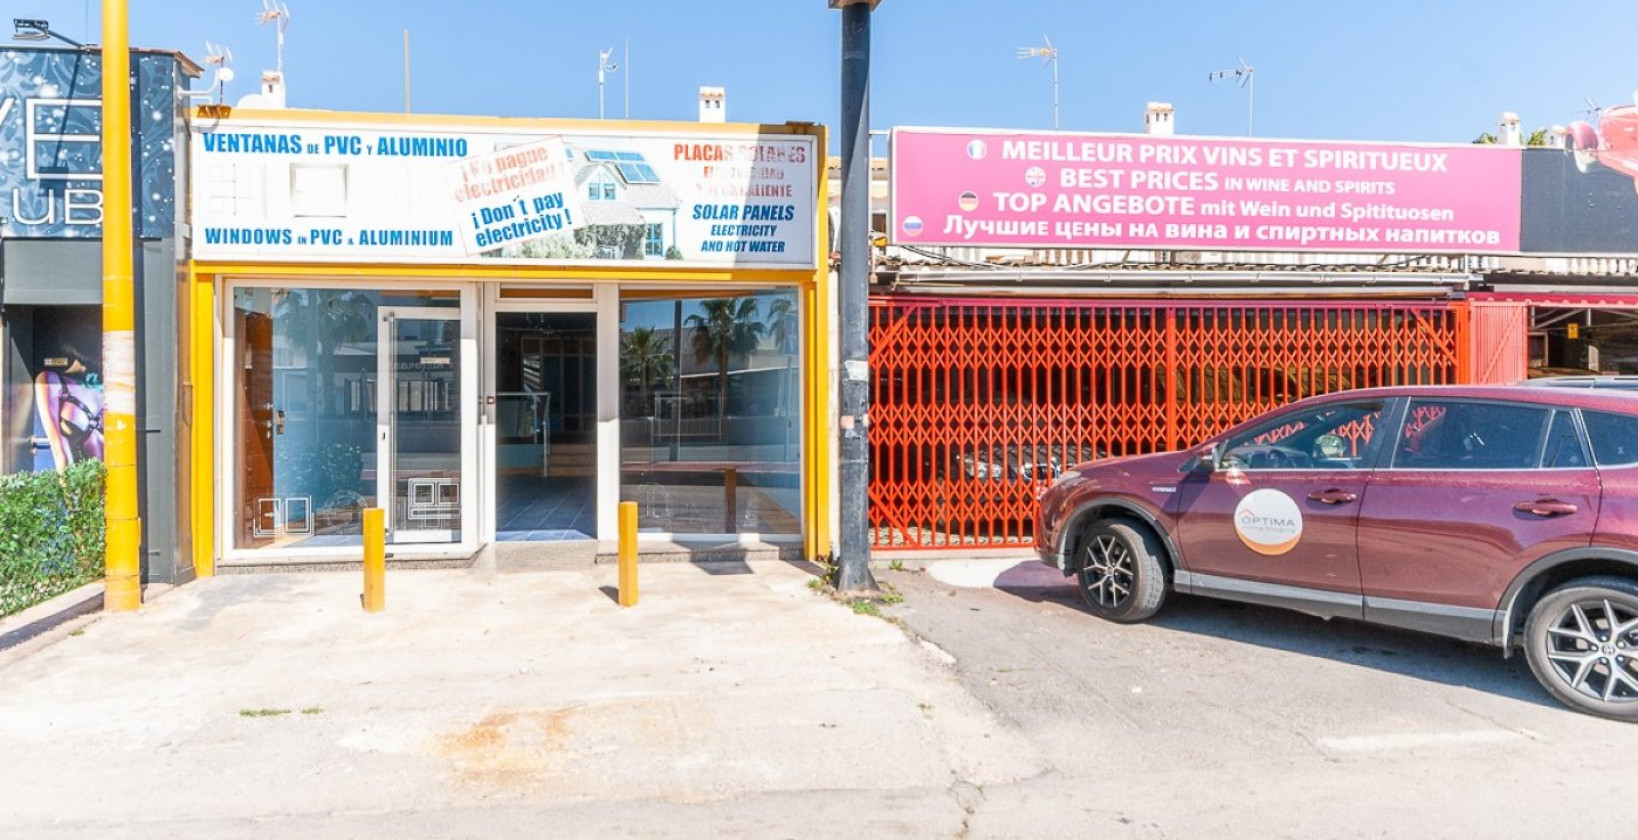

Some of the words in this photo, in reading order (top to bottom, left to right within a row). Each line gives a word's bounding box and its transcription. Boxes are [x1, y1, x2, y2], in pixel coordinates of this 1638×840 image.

[203, 133, 302, 154] VENTANAS
[307, 144, 320, 154] DE
[324, 136, 362, 155] PVC
[367, 146, 373, 156] Y
[377, 137, 468, 157] ALUMINIO
[1002, 140, 1133, 163] MEILLEUR
[1139, 144, 1198, 164] PRIX
[1203, 147, 1262, 167] VINS
[1269, 149, 1298, 167] ET
[1304, 150, 1448, 172] SPIRITUEUX
[495, 147, 549, 173] pague
[1060, 169, 1124, 188] BEST
[1131, 170, 1219, 191] PRICES
[1225, 177, 1242, 190] IN
[1246, 179, 1290, 192] WINE
[1294, 180, 1331, 193] AND
[1334, 181, 1396, 195] SPIRITS
[0, 188, 104, 225] UB
[533, 192, 564, 214] pay
[693, 204, 739, 219] SOLAR
[743, 205, 795, 220] PANELS
[994, 192, 1047, 213] TOP
[1053, 195, 1195, 216] ANGEBOTE
[1201, 200, 1236, 216] mit
[1240, 201, 1292, 217] Wein
[1297, 203, 1336, 218] und
[1341, 203, 1454, 222] Spitituosen
[205, 228, 292, 245] WINDOWS
[310, 229, 343, 246] PVC
[359, 230, 453, 246] ALUMINIUM
[475, 213, 563, 247] electricity
[711, 225, 777, 237] ELECTRICITY
[1165, 223, 1228, 239] вина
[1234, 226, 1250, 239] и
[1256, 225, 1380, 244] спиртных
[1385, 229, 1501, 245] напитков
[701, 240, 723, 252] AND
[726, 241, 748, 252] HOT
[750, 241, 785, 253] WATER
[1241, 516, 1295, 527] OPTIMA
